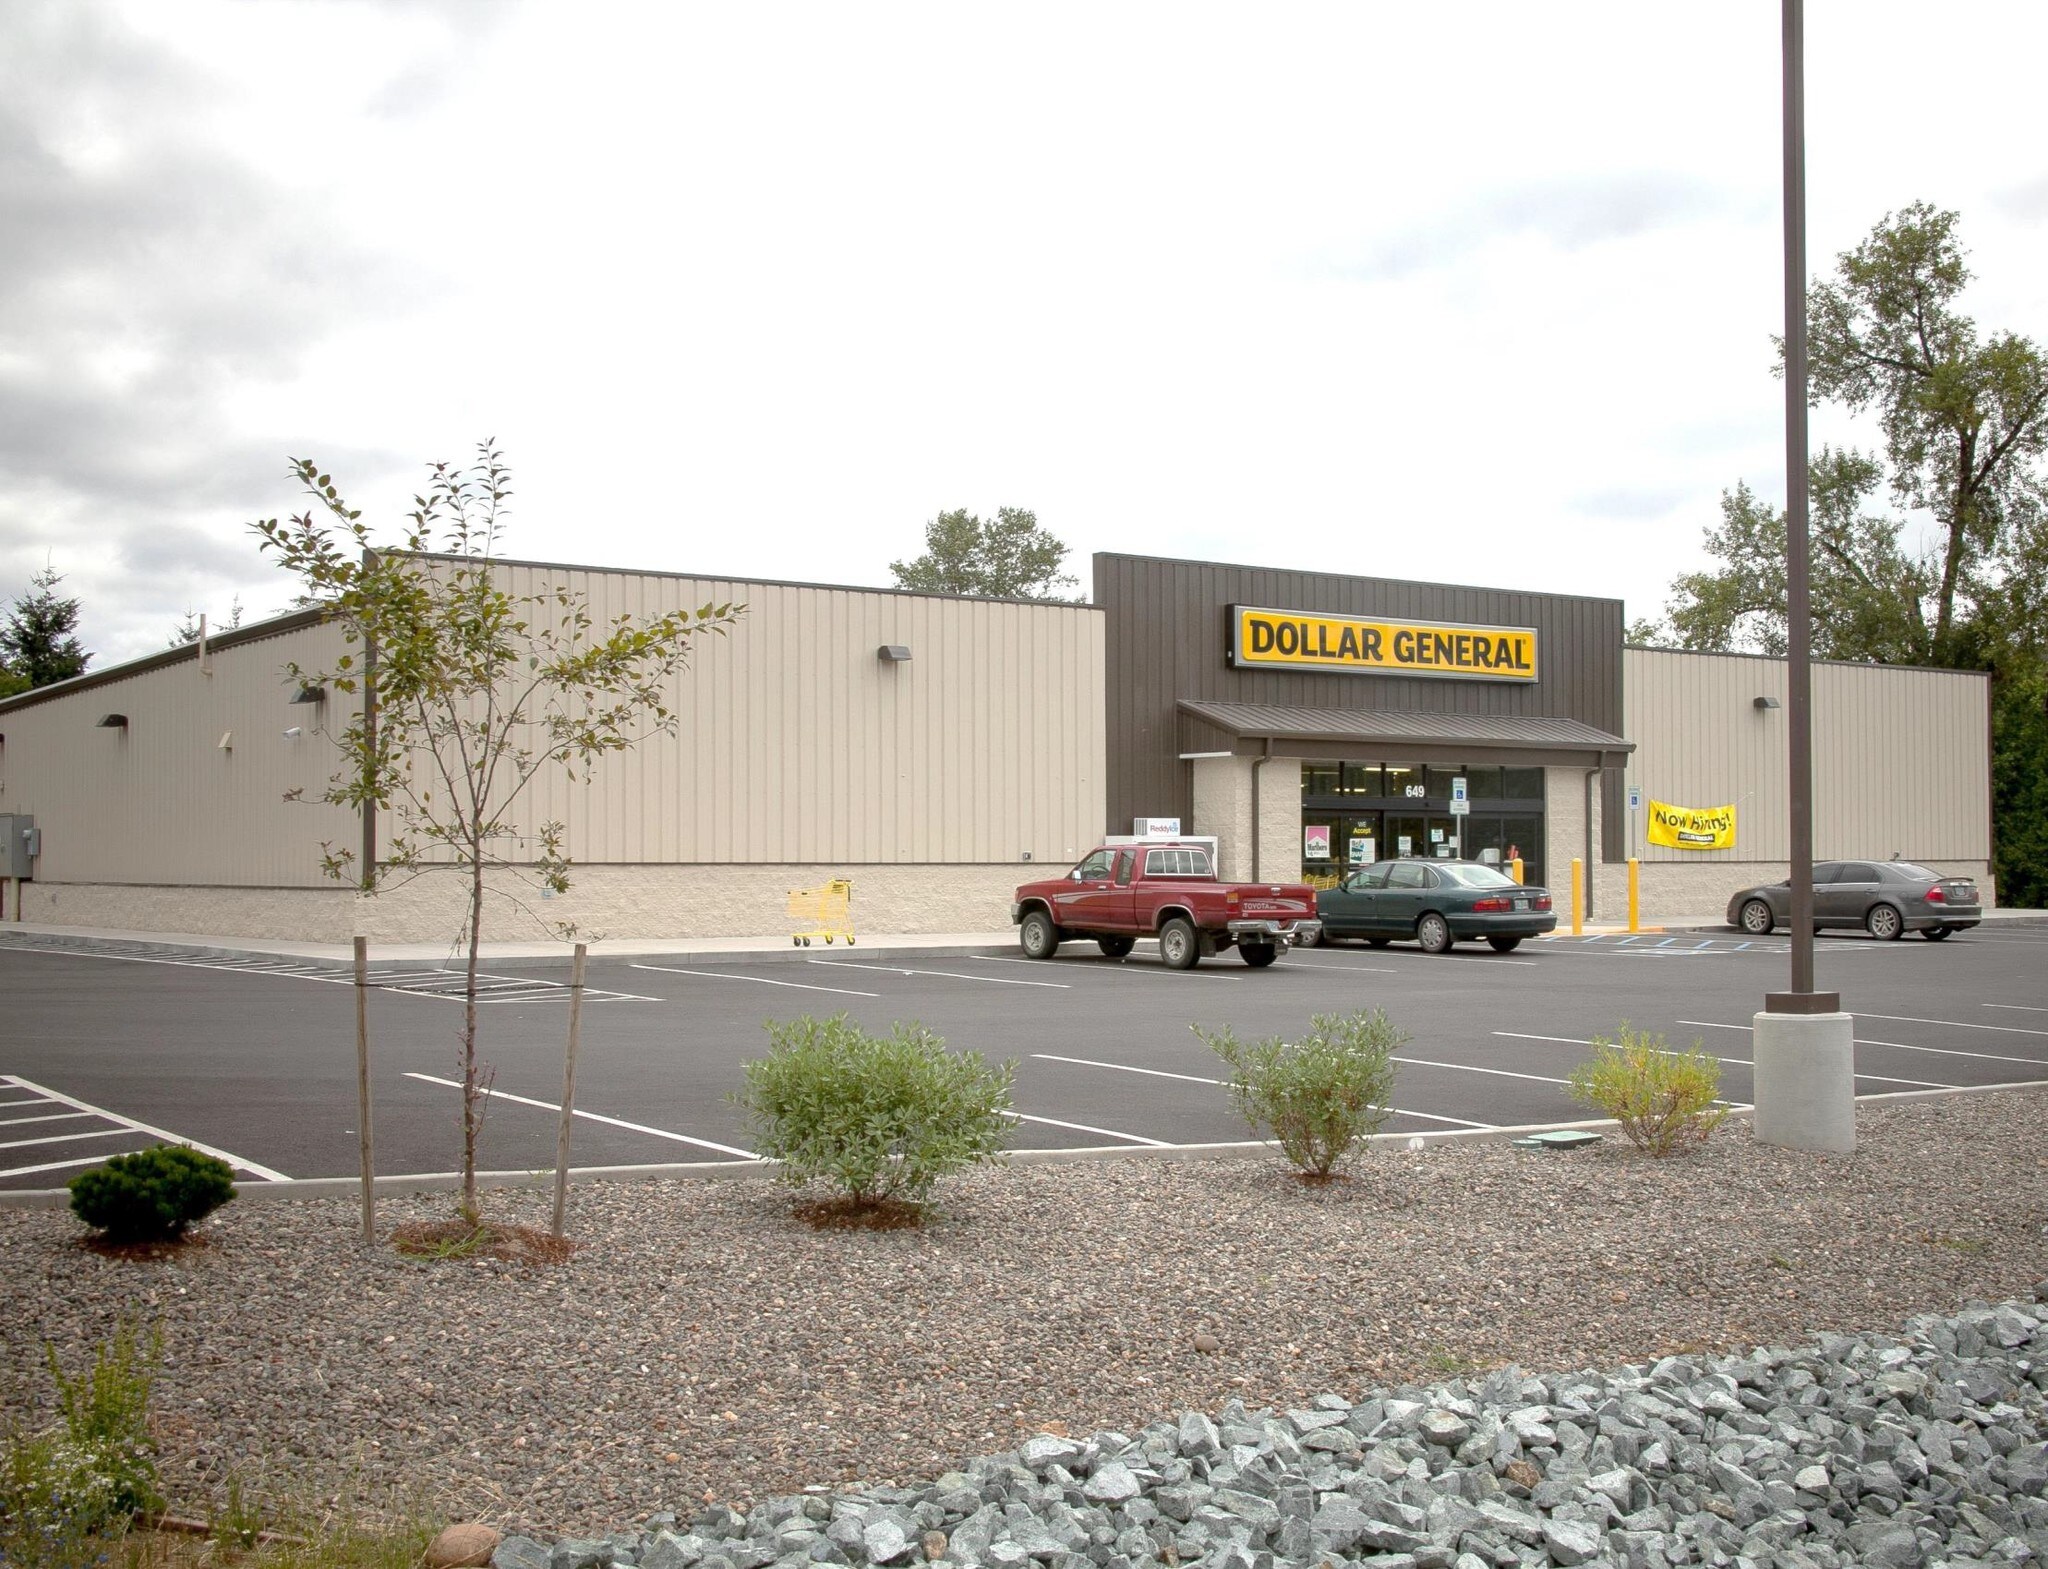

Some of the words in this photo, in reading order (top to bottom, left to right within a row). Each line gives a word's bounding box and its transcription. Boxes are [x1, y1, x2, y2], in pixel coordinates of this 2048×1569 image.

[1250, 619, 1383, 661] DOLLAR
[1393, 630, 1531, 670] GENERAL
[1405, 785, 1425, 797] 649
[1655, 810, 1688, 828] Now
[1243, 902, 1270, 910] TOYOTA
